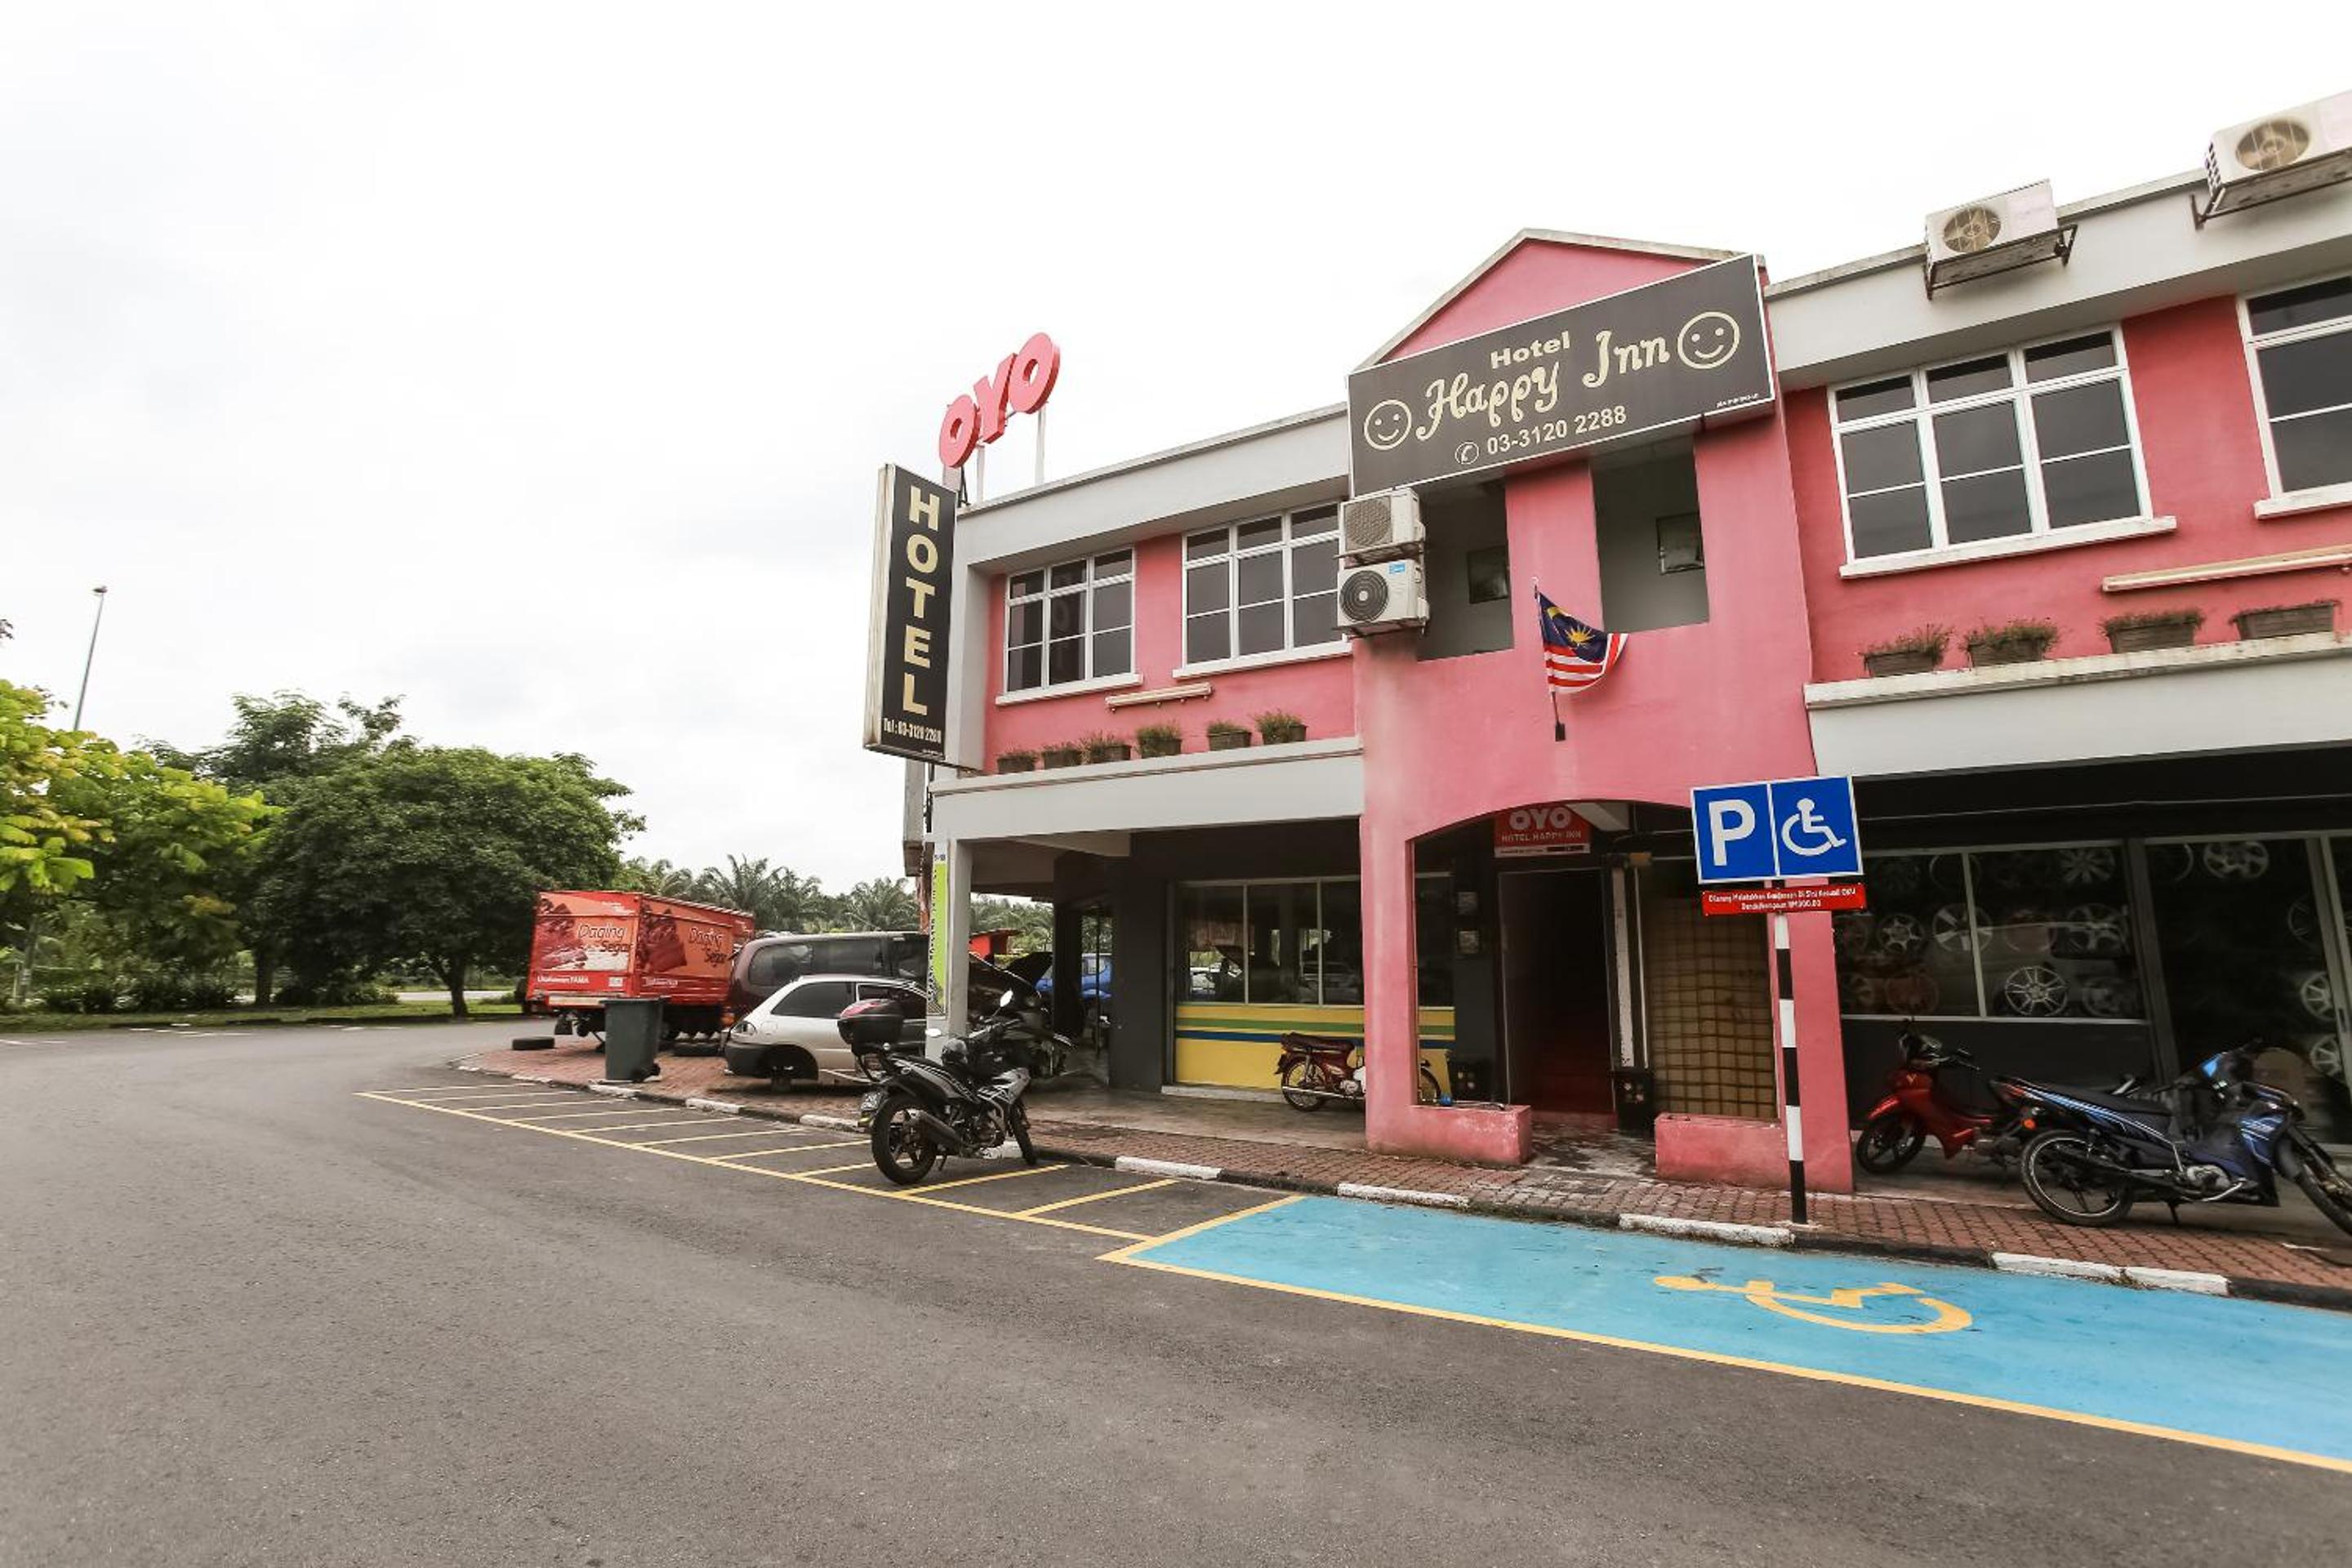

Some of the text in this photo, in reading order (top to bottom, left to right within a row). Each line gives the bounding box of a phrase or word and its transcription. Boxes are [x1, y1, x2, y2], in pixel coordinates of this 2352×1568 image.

[1490, 331, 1570, 369] Hotel
[938, 332, 1060, 469] OYO
[1415, 330, 1670, 442] Happy Inn
[1487, 405, 1627, 456] 03-3120 2288
[902, 485, 939, 715] HOTEL
[1502, 833, 1531, 842] HOTEL
[1566, 830, 1582, 839] INN
[1509, 807, 1572, 830] OYO
[1708, 799, 1756, 866] P
[578, 924, 626, 942] Daging
[600, 940, 634, 956] Segar
[688, 926, 724, 951] Daging
